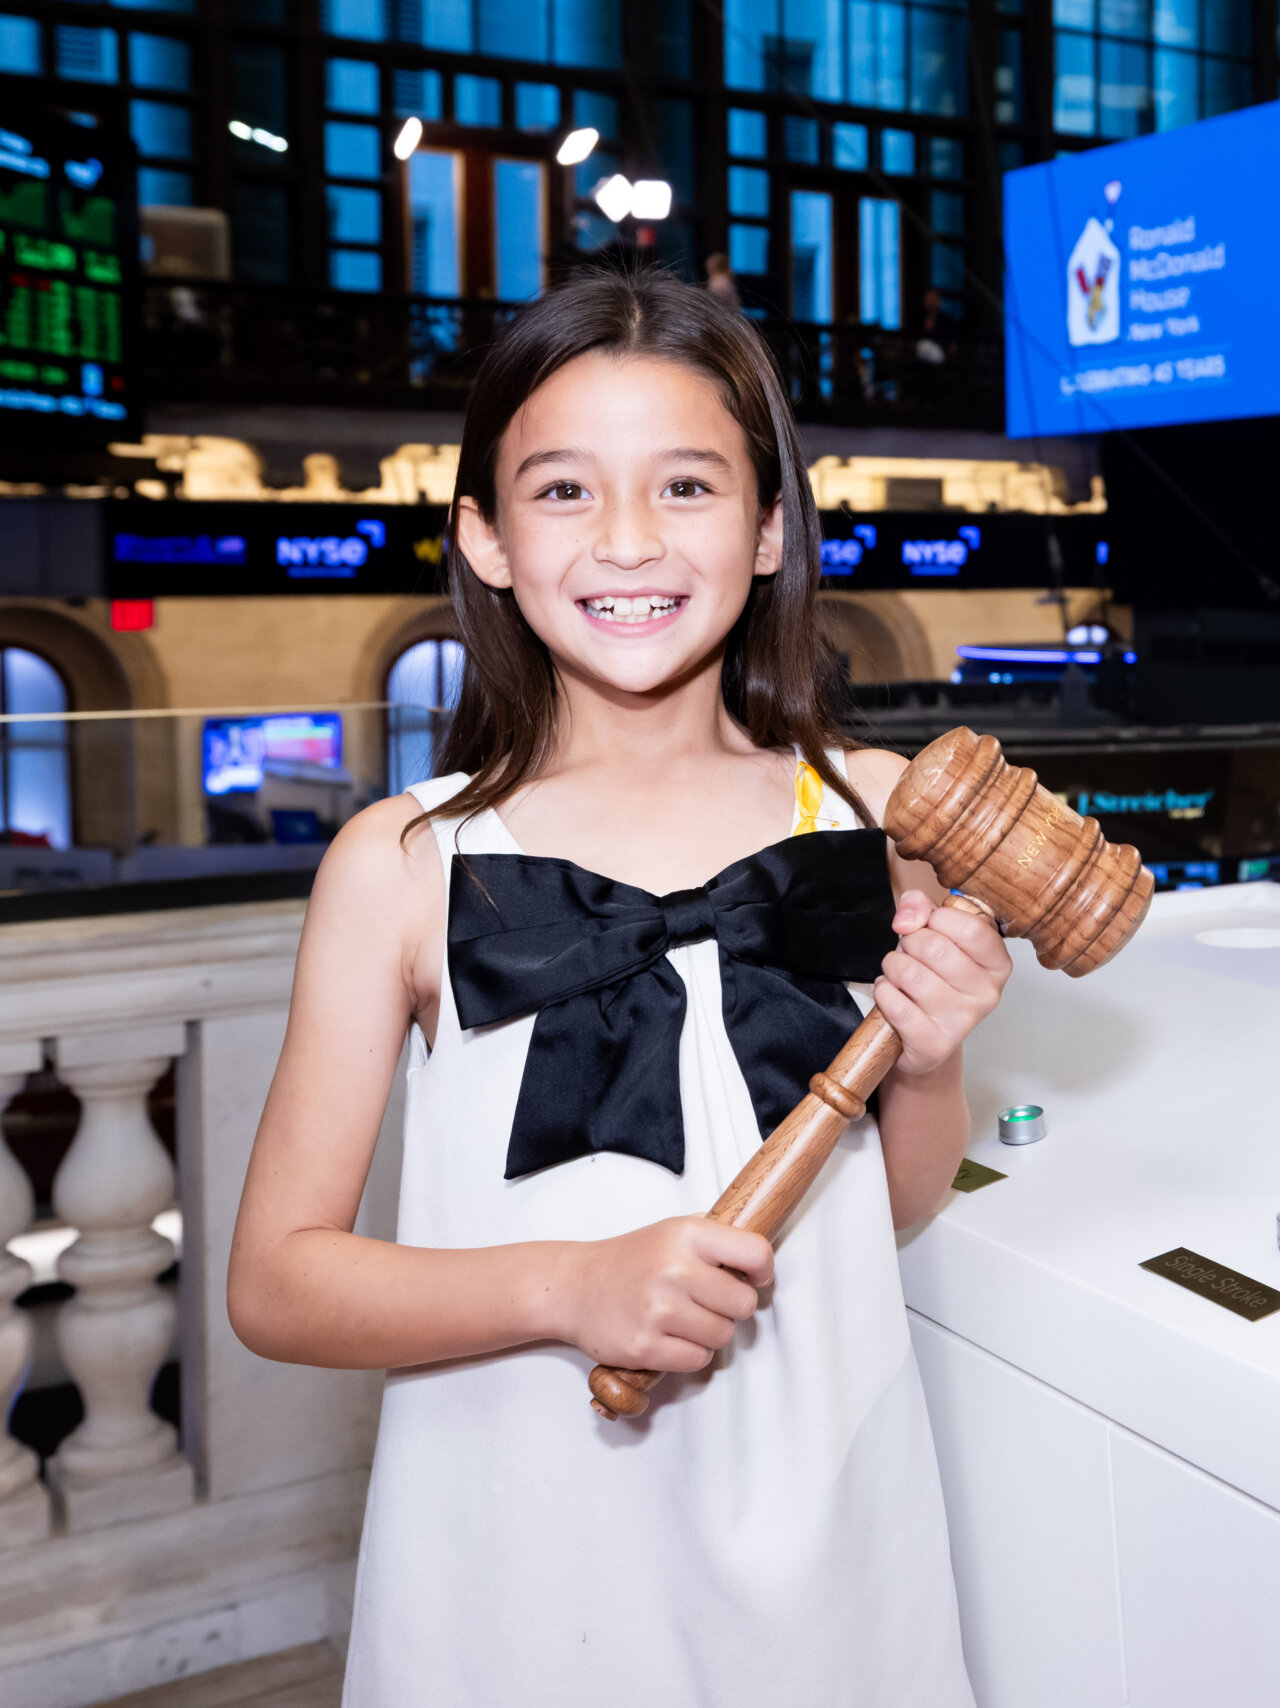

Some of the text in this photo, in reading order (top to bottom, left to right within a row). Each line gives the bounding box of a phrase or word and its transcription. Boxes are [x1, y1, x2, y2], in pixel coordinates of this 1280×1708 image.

[1129, 216, 1196, 251] Ronald
[1129, 242, 1226, 282] McDonald
[1129, 286, 1191, 313] House
[276, 536, 368, 567] NYSE
[901, 540, 968, 566] NYSE
[1016, 802, 1063, 869] NEW YOR
[1165, 1255, 1268, 1308] Single Stroke
